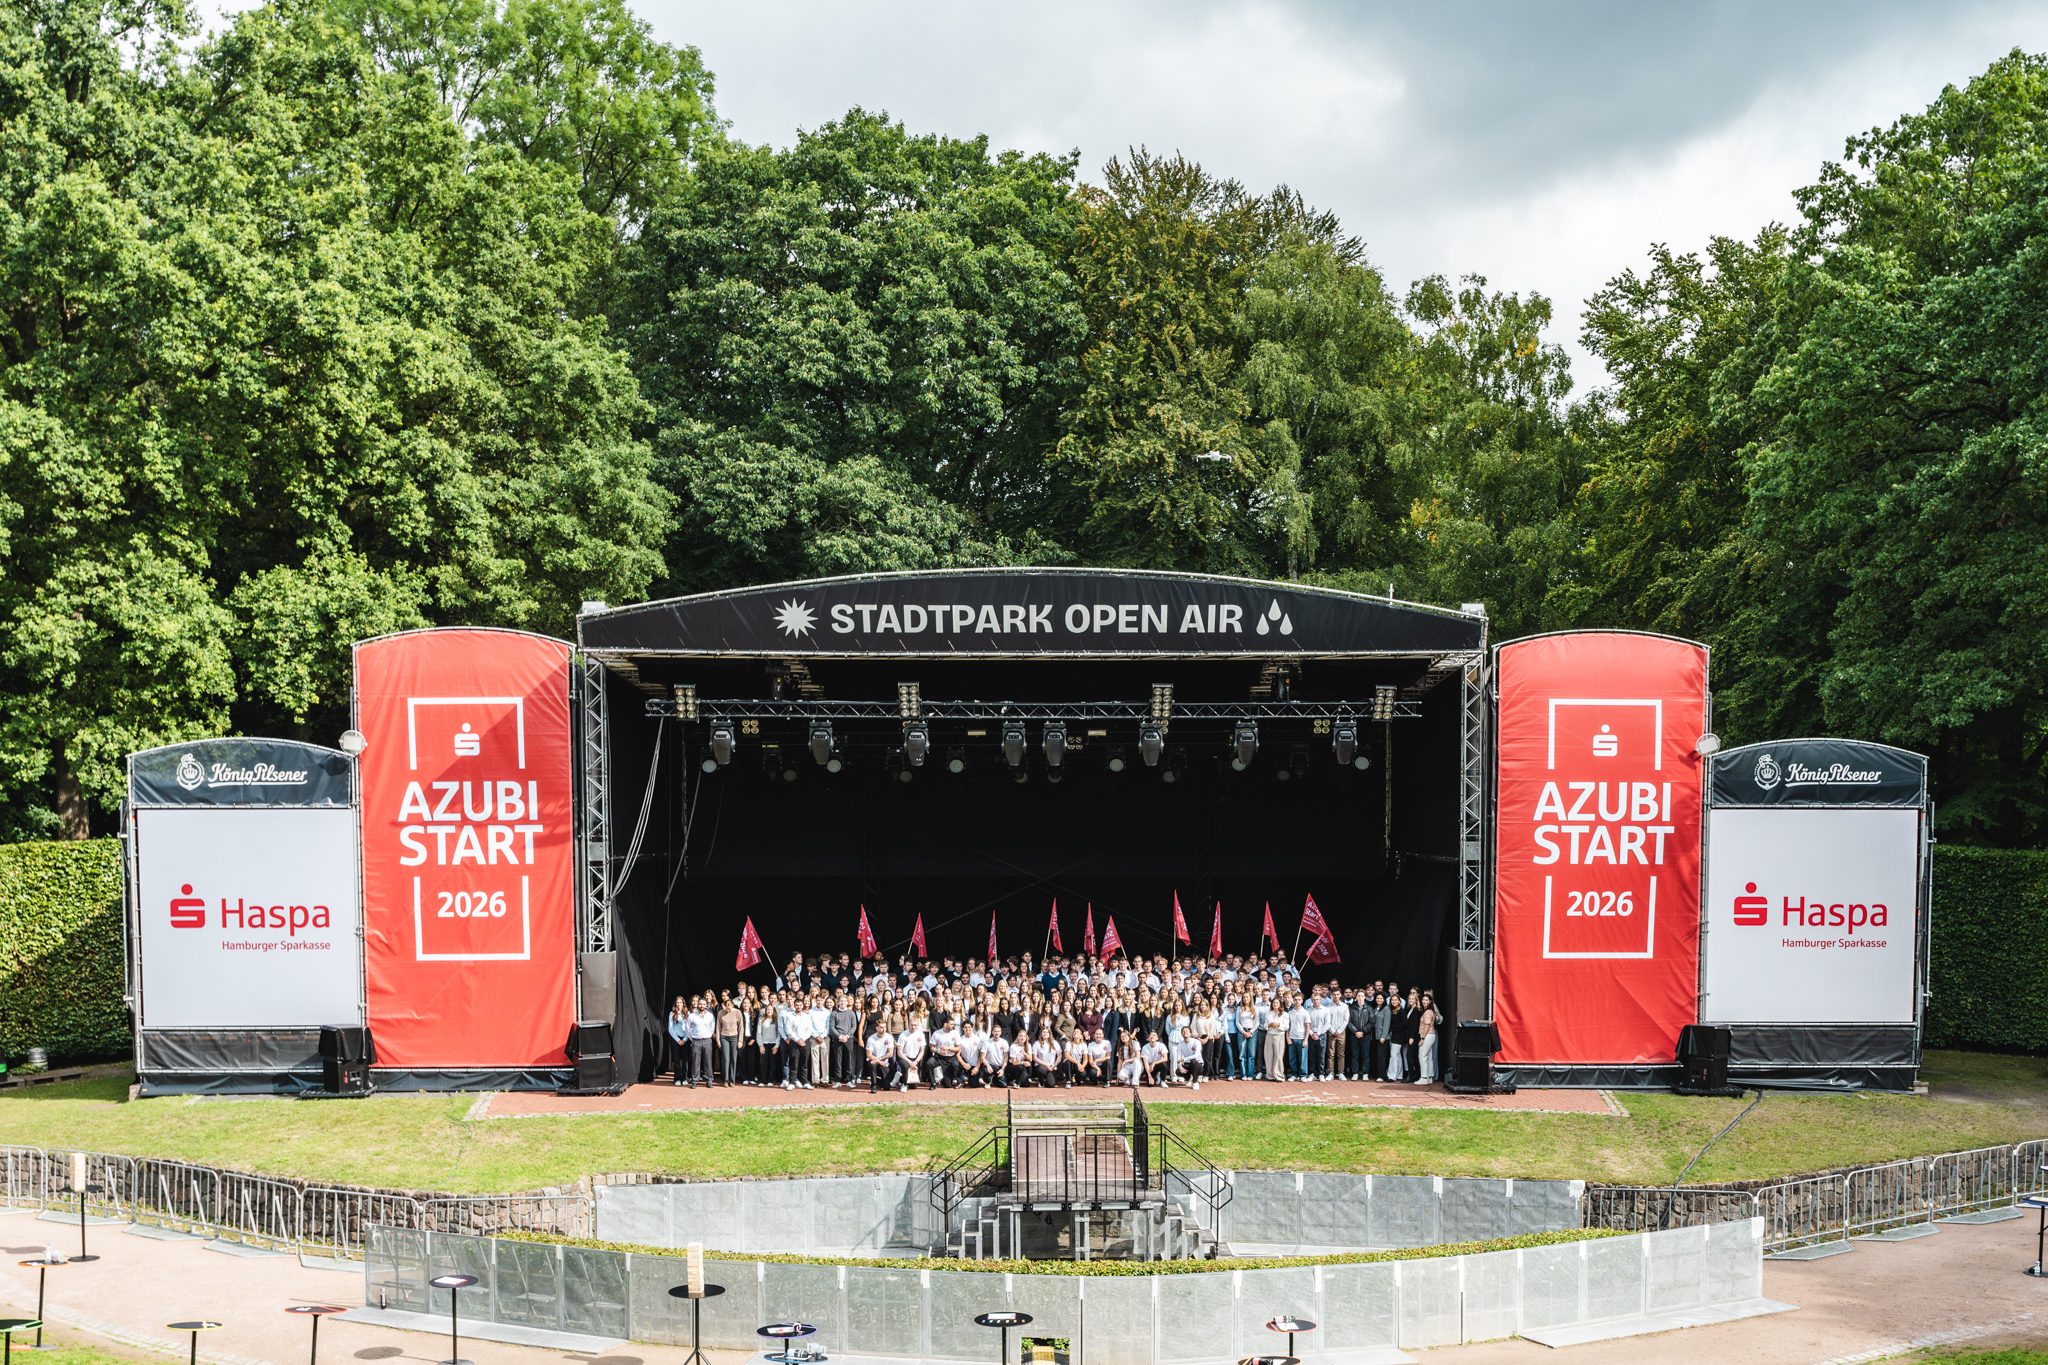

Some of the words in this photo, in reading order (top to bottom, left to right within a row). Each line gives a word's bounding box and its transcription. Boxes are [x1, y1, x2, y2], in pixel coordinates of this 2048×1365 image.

[831, 604, 1053, 634] STADTPARK
[1065, 604, 1168, 633] OPEN
[1179, 604, 1243, 633] AIR
[398, 780, 538, 822] AZUBI
[1533, 781, 1672, 822] AZUBI
[400, 824, 543, 867] START
[1533, 825, 1675, 865] START
[221, 898, 330, 937] Haspa
[437, 891, 507, 918] 2026
[1566, 891, 1634, 917] 2026
[1782, 897, 1887, 935] Haspa
[222, 941, 278, 952] Hamburger
[280, 941, 331, 952] Sparkasse
[1782, 938, 1837, 950] Hamburger
[1838, 938, 1887, 950] Sparkasse
